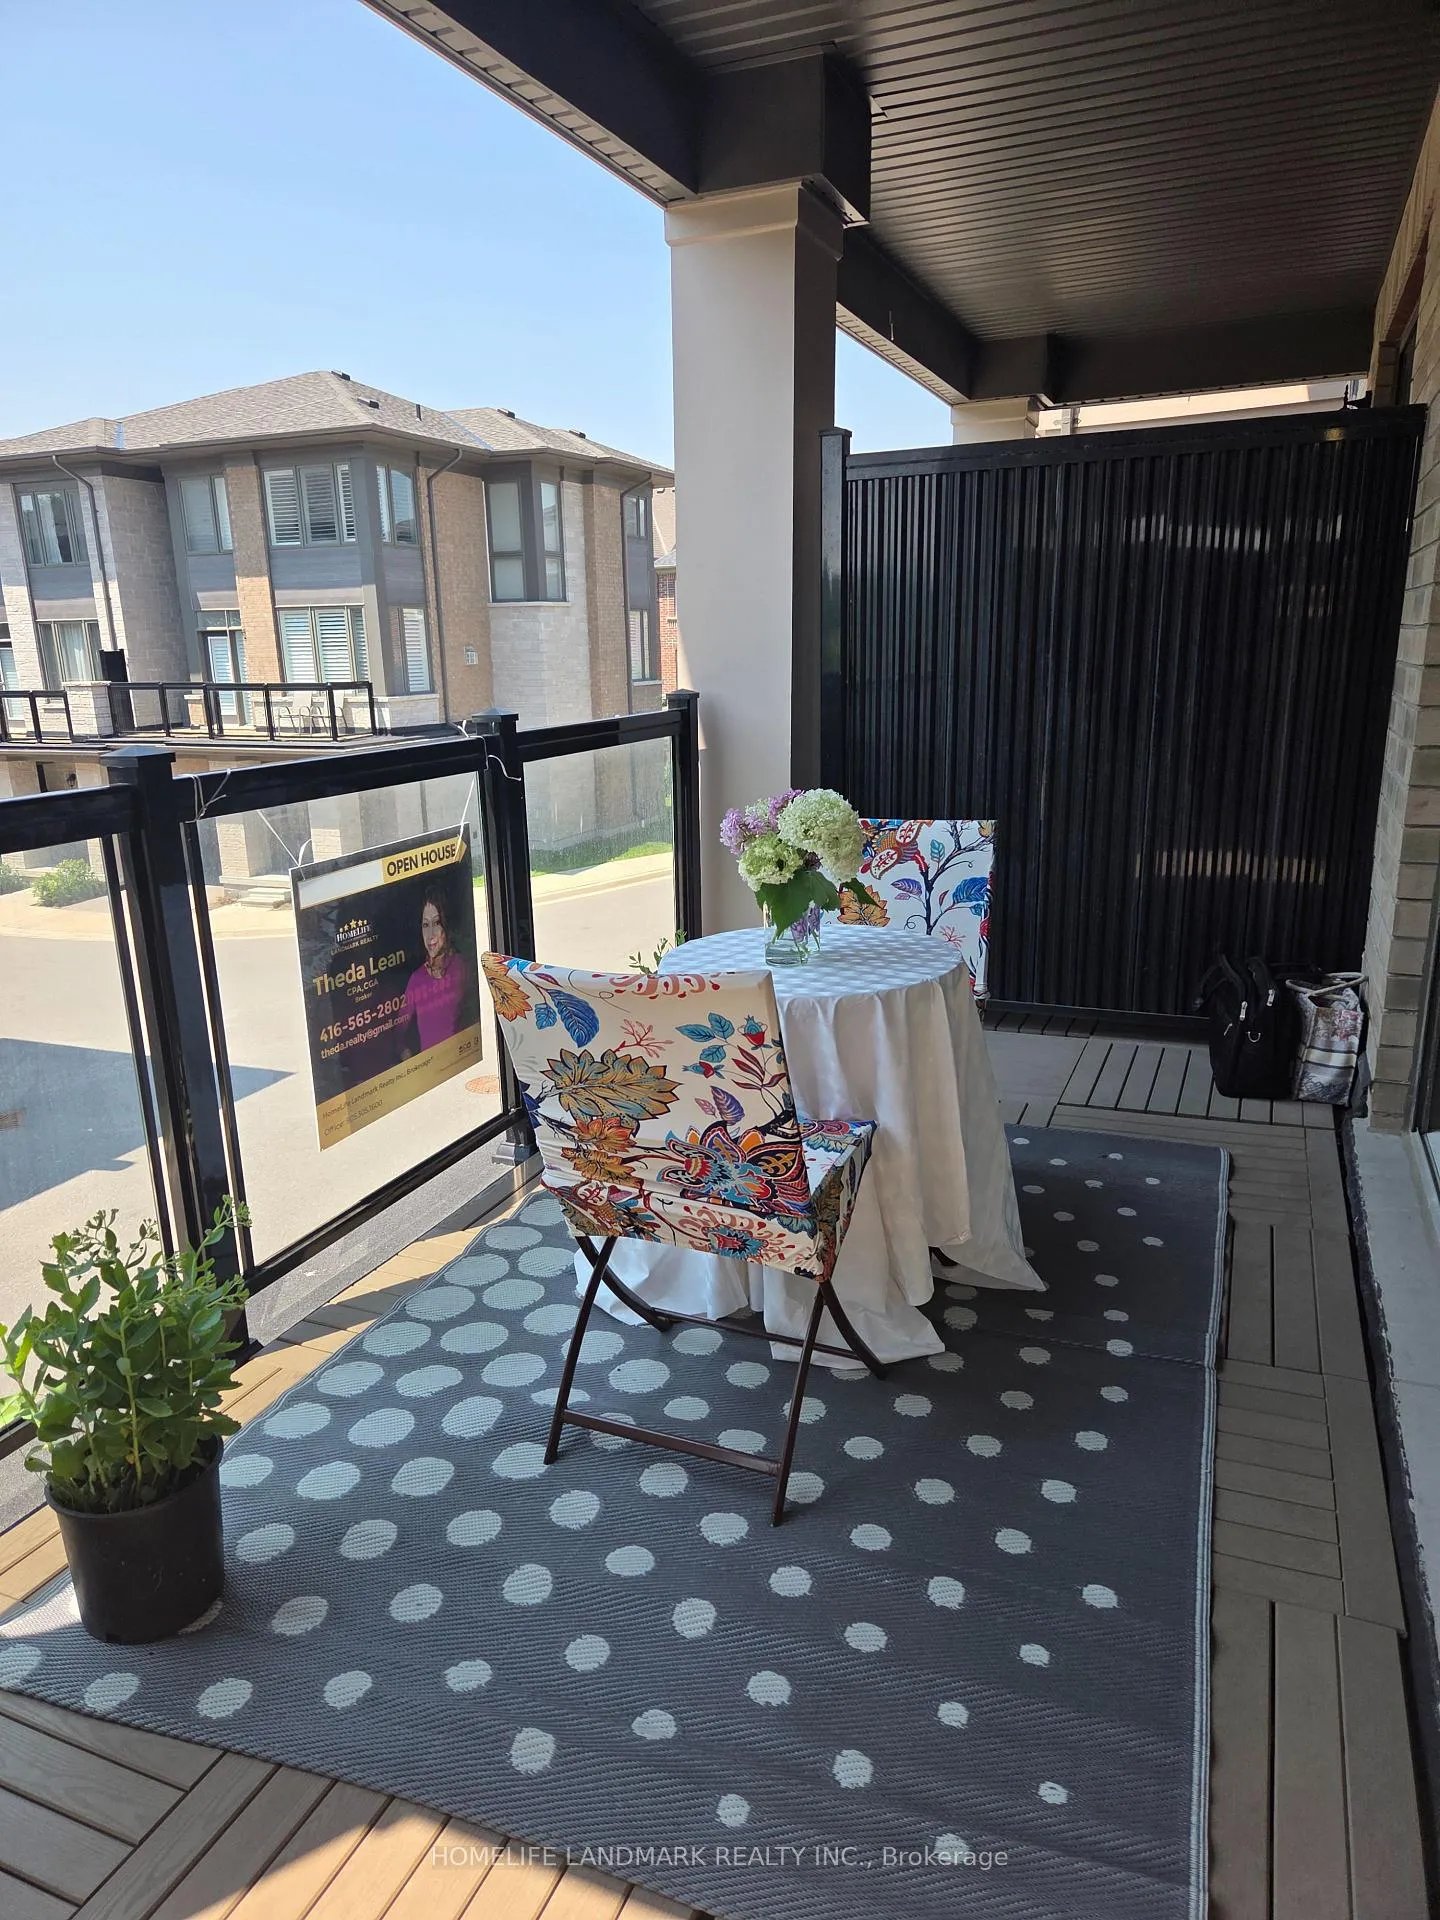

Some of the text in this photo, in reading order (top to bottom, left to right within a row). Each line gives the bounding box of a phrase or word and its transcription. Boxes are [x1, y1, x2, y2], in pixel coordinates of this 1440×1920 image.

[387, 843, 456, 877] OPEN HOUSE
[313, 949, 405, 996] Theda Lean
[320, 993, 407, 1042] 416-565-2802
[321, 1013, 409, 1059] theda.realty@gmail.com
